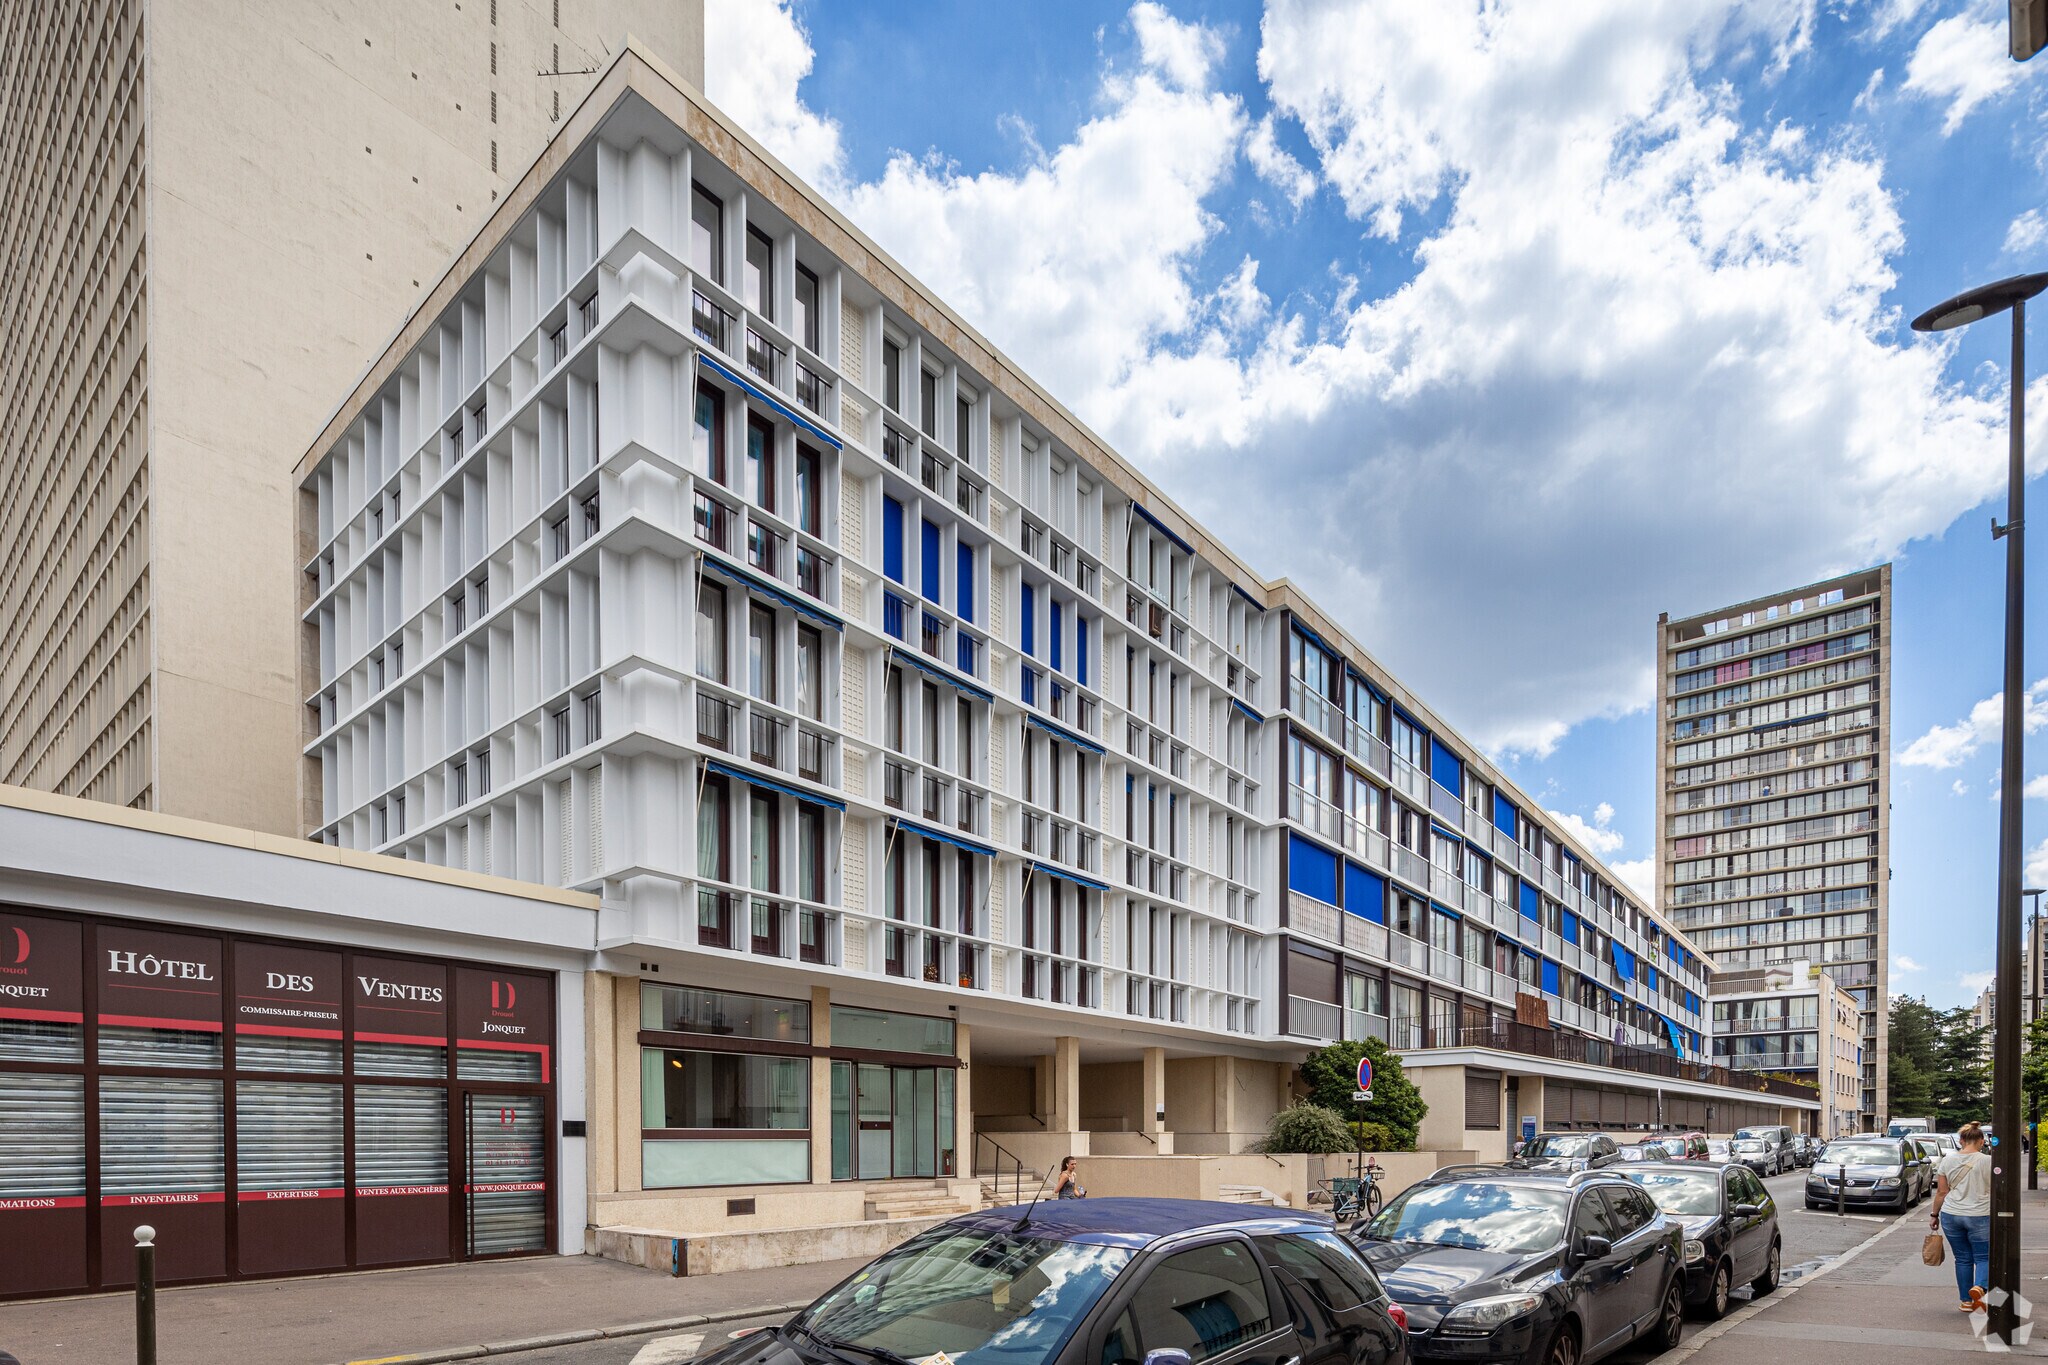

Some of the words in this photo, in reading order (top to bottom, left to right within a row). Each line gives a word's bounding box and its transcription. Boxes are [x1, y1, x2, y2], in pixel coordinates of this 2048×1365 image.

[107, 949, 214, 981] HÔTEL
[266, 972, 314, 992] DES
[357, 976, 443, 1003] VENTES
[240, 1005, 338, 1020] COMMISSAIRE-PRISEUR
[481, 1021, 526, 1035] JONQUET
[960, 1062, 968, 1070] 25
[267, 1190, 319, 1199] EXPERTISES
[357, 1188, 389, 1196] VENTES
[407, 1185, 448, 1194] ENCHÈRES
[130, 1194, 199, 1204] INVENTAIRES
